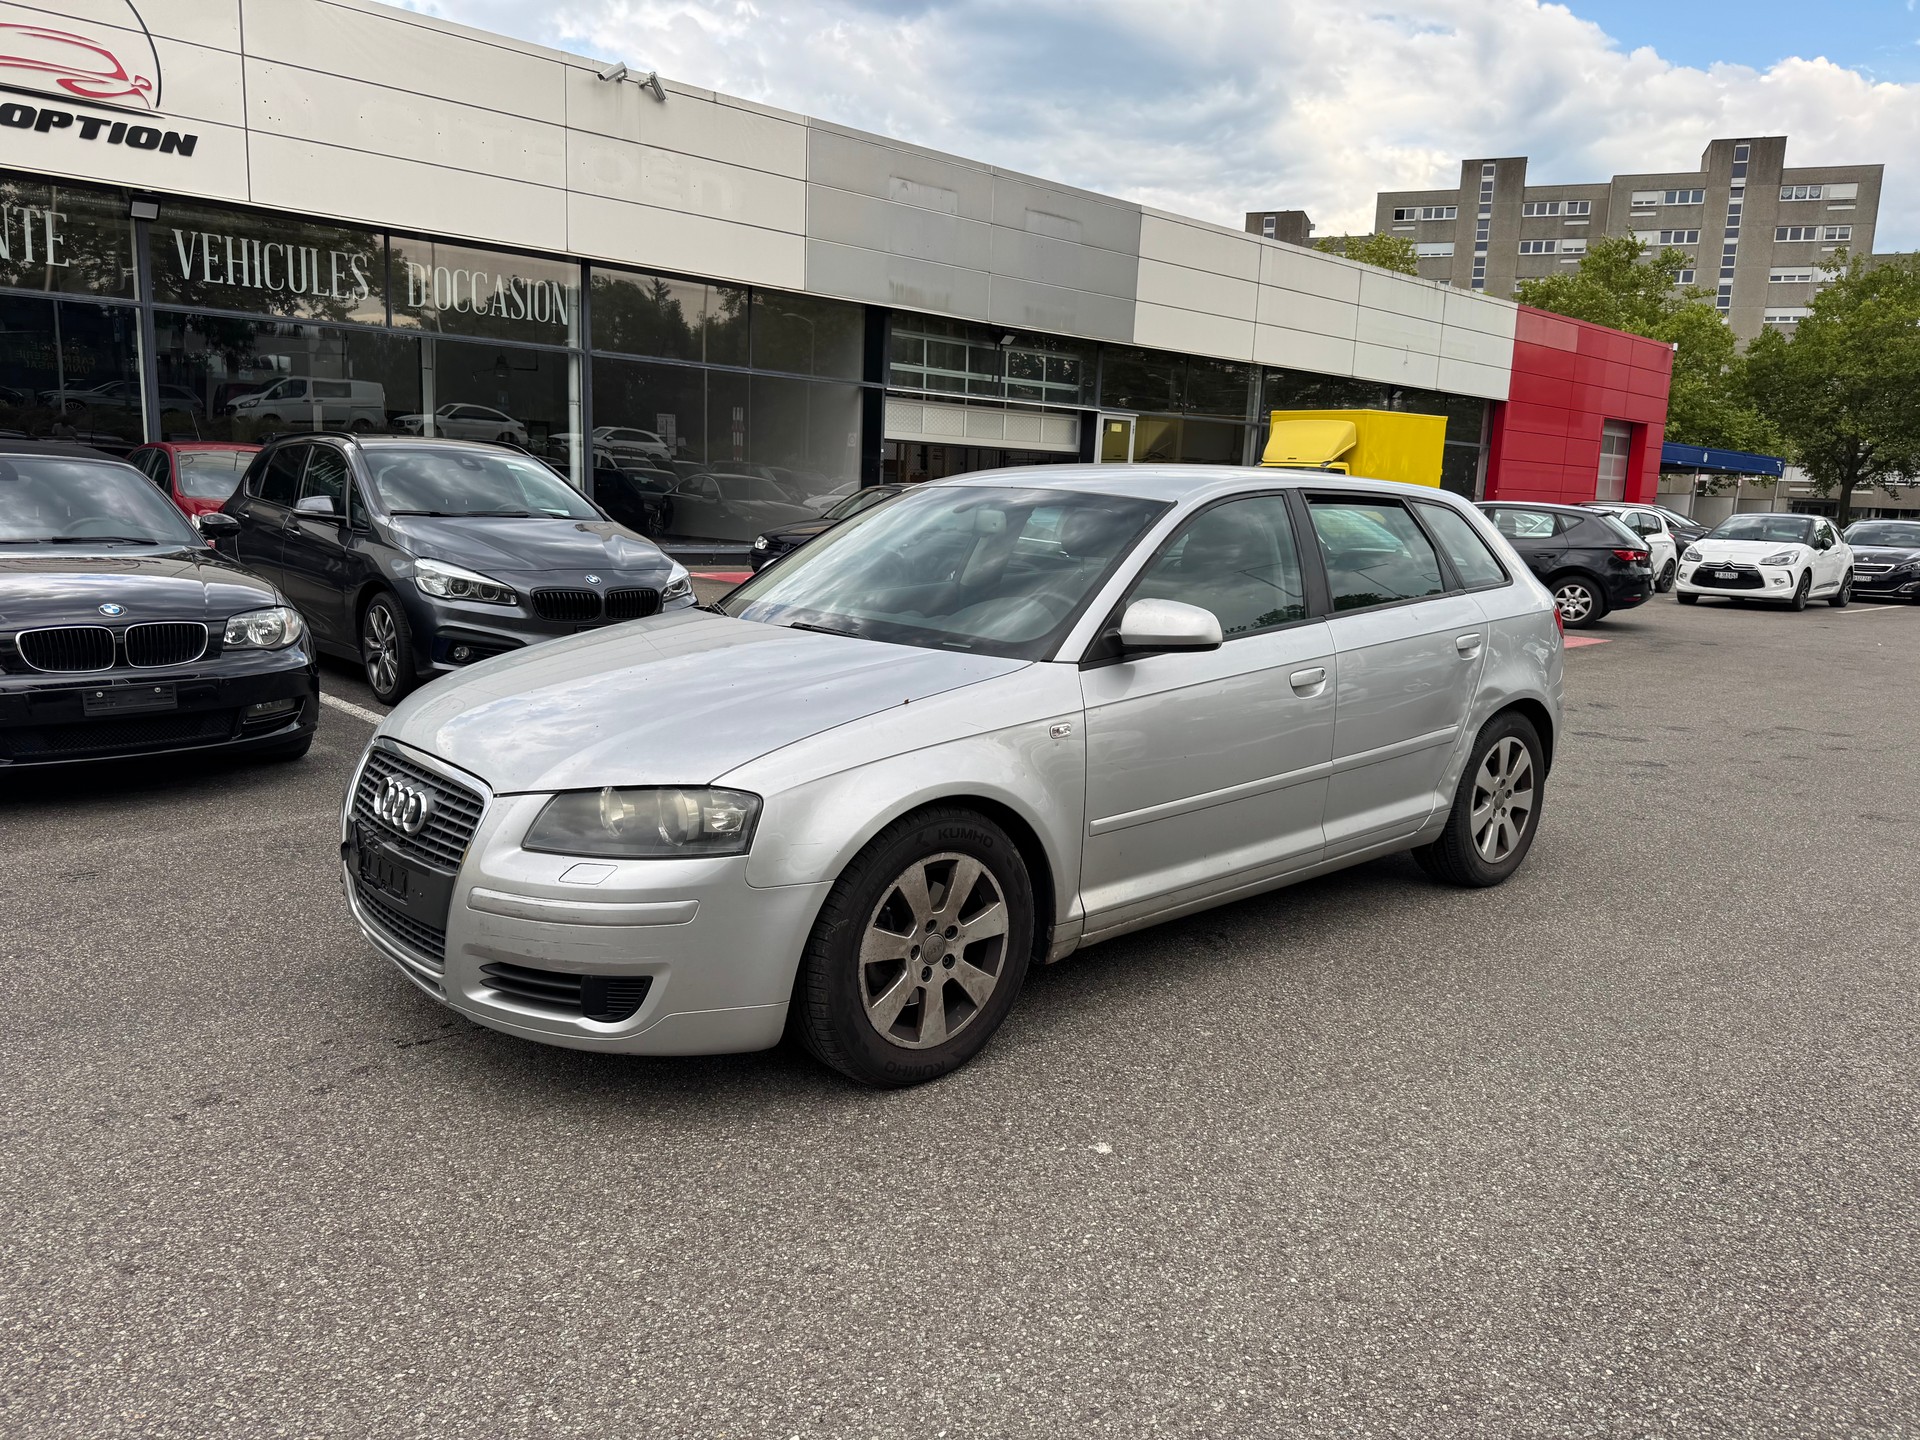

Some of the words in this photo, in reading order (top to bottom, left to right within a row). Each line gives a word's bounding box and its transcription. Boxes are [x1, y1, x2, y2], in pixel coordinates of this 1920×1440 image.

[0, 102, 199, 157] OPTION
[171, 228, 369, 301] VEHICULES
[406, 261, 569, 326] D'OCCASION
[938, 827, 994, 848] KUMHO
[884, 1060, 946, 1077] KUMHO
